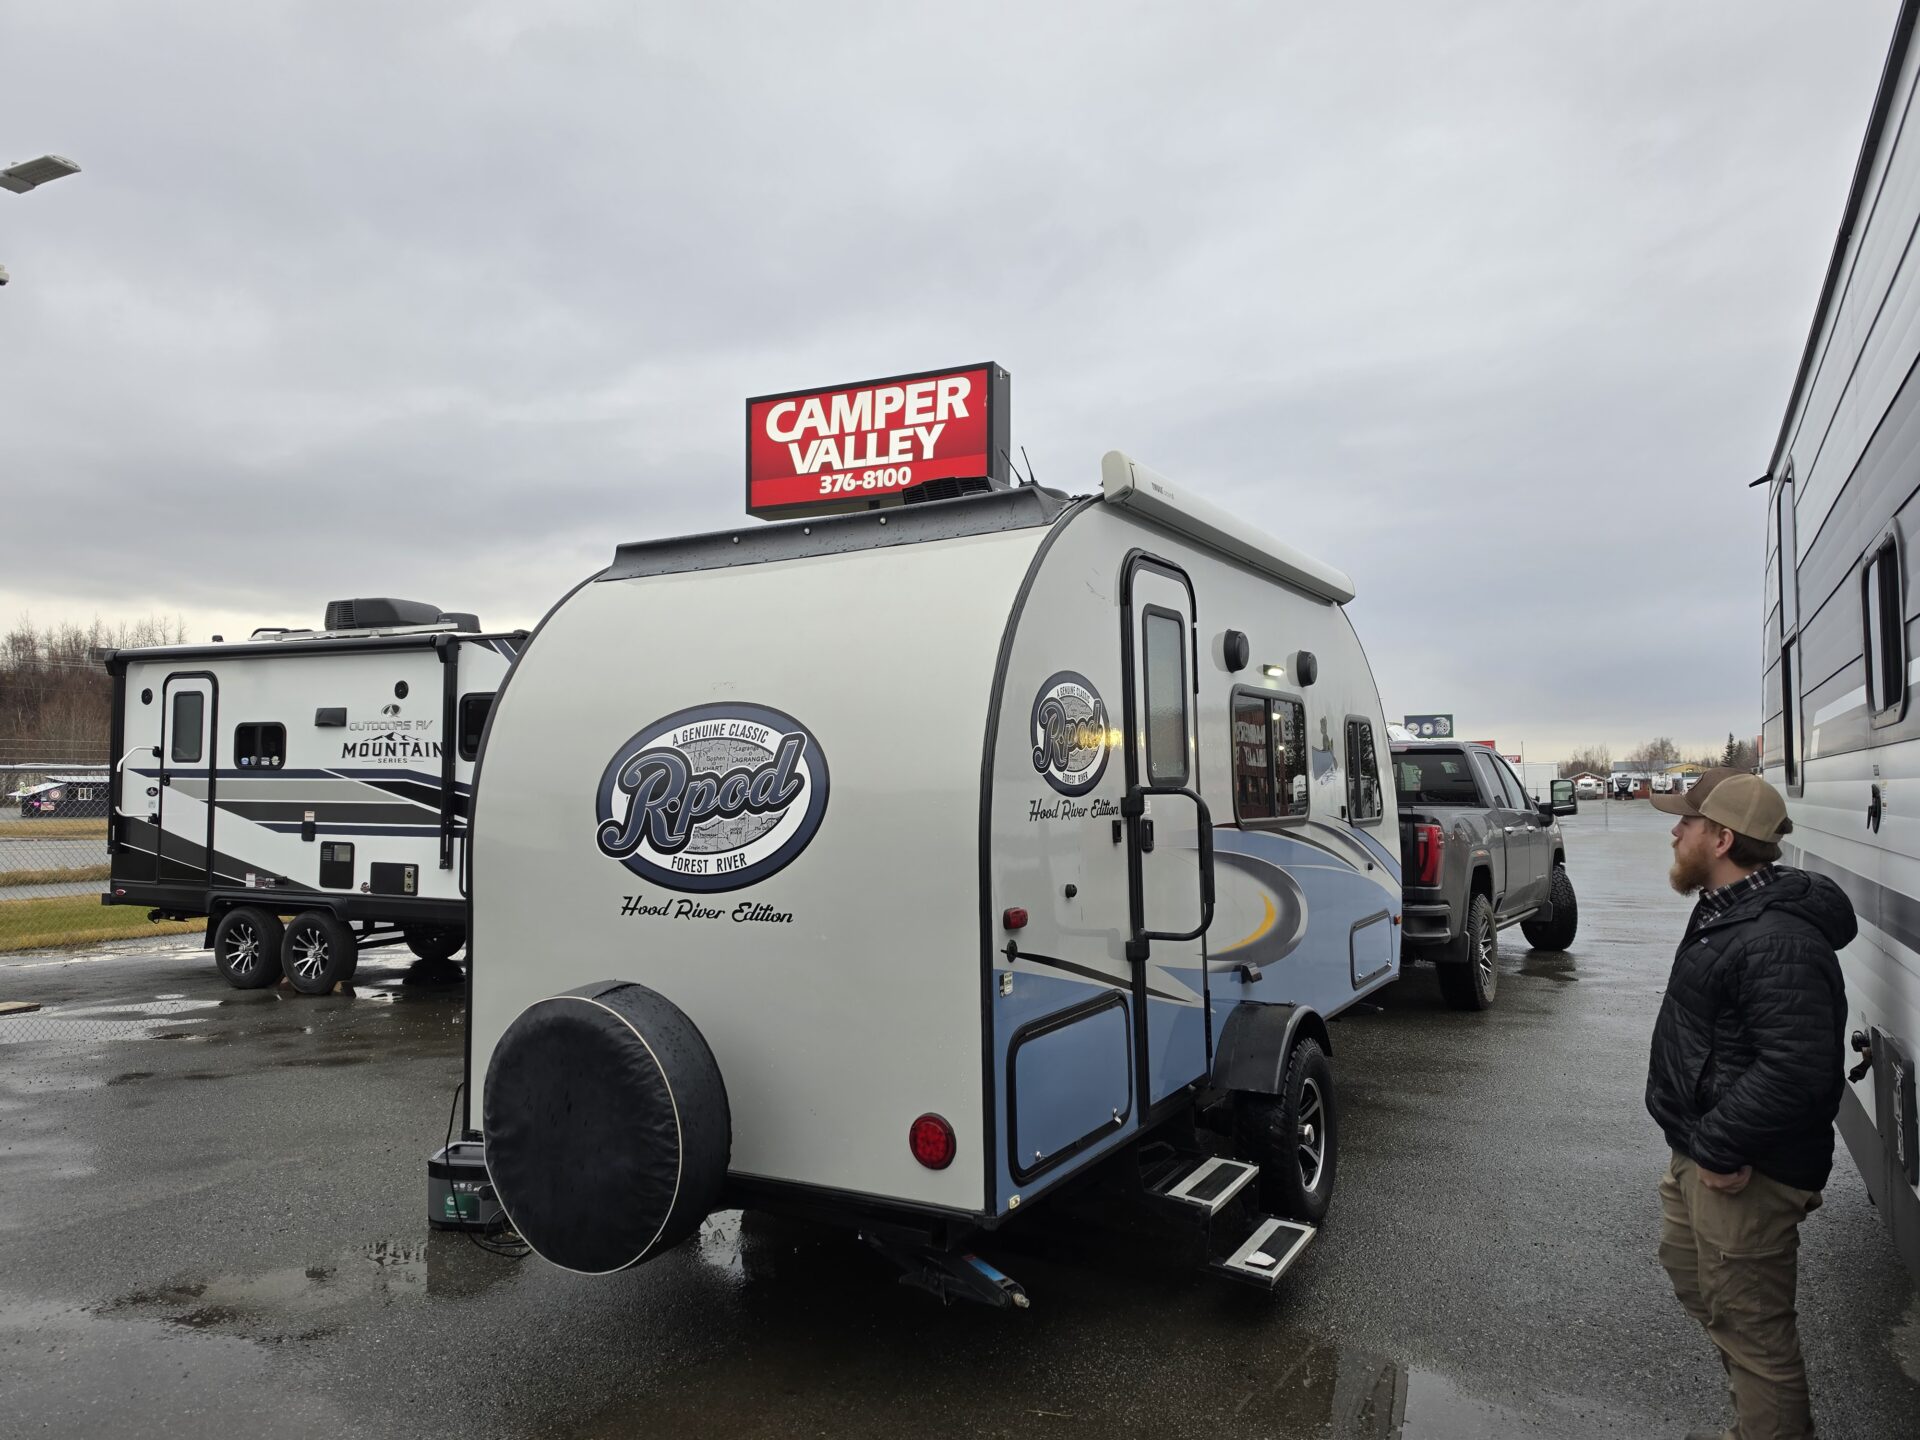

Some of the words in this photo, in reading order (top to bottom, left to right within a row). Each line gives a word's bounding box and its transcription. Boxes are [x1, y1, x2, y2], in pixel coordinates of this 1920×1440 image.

[765, 376, 972, 443] CAMPER
[788, 423, 946, 475] VALLEY
[819, 466, 912, 494] 376-8100
[349, 720, 412, 731] OUTDOORS
[415, 720, 434, 731] RV
[672, 733, 679, 746] A
[682, 723, 727, 742] GENUINE
[728, 723, 769, 744] CLASSIC
[341, 741, 443, 759] MOUNTAIN
[1029, 798, 1060, 821] Hood
[1061, 799, 1088, 821] River
[1091, 799, 1120, 819] Edition
[671, 856, 709, 874] FOREST
[716, 852, 748, 873] RIVER
[621, 895, 672, 917] Hood
[674, 898, 726, 920] River
[731, 902, 794, 923] Edition
